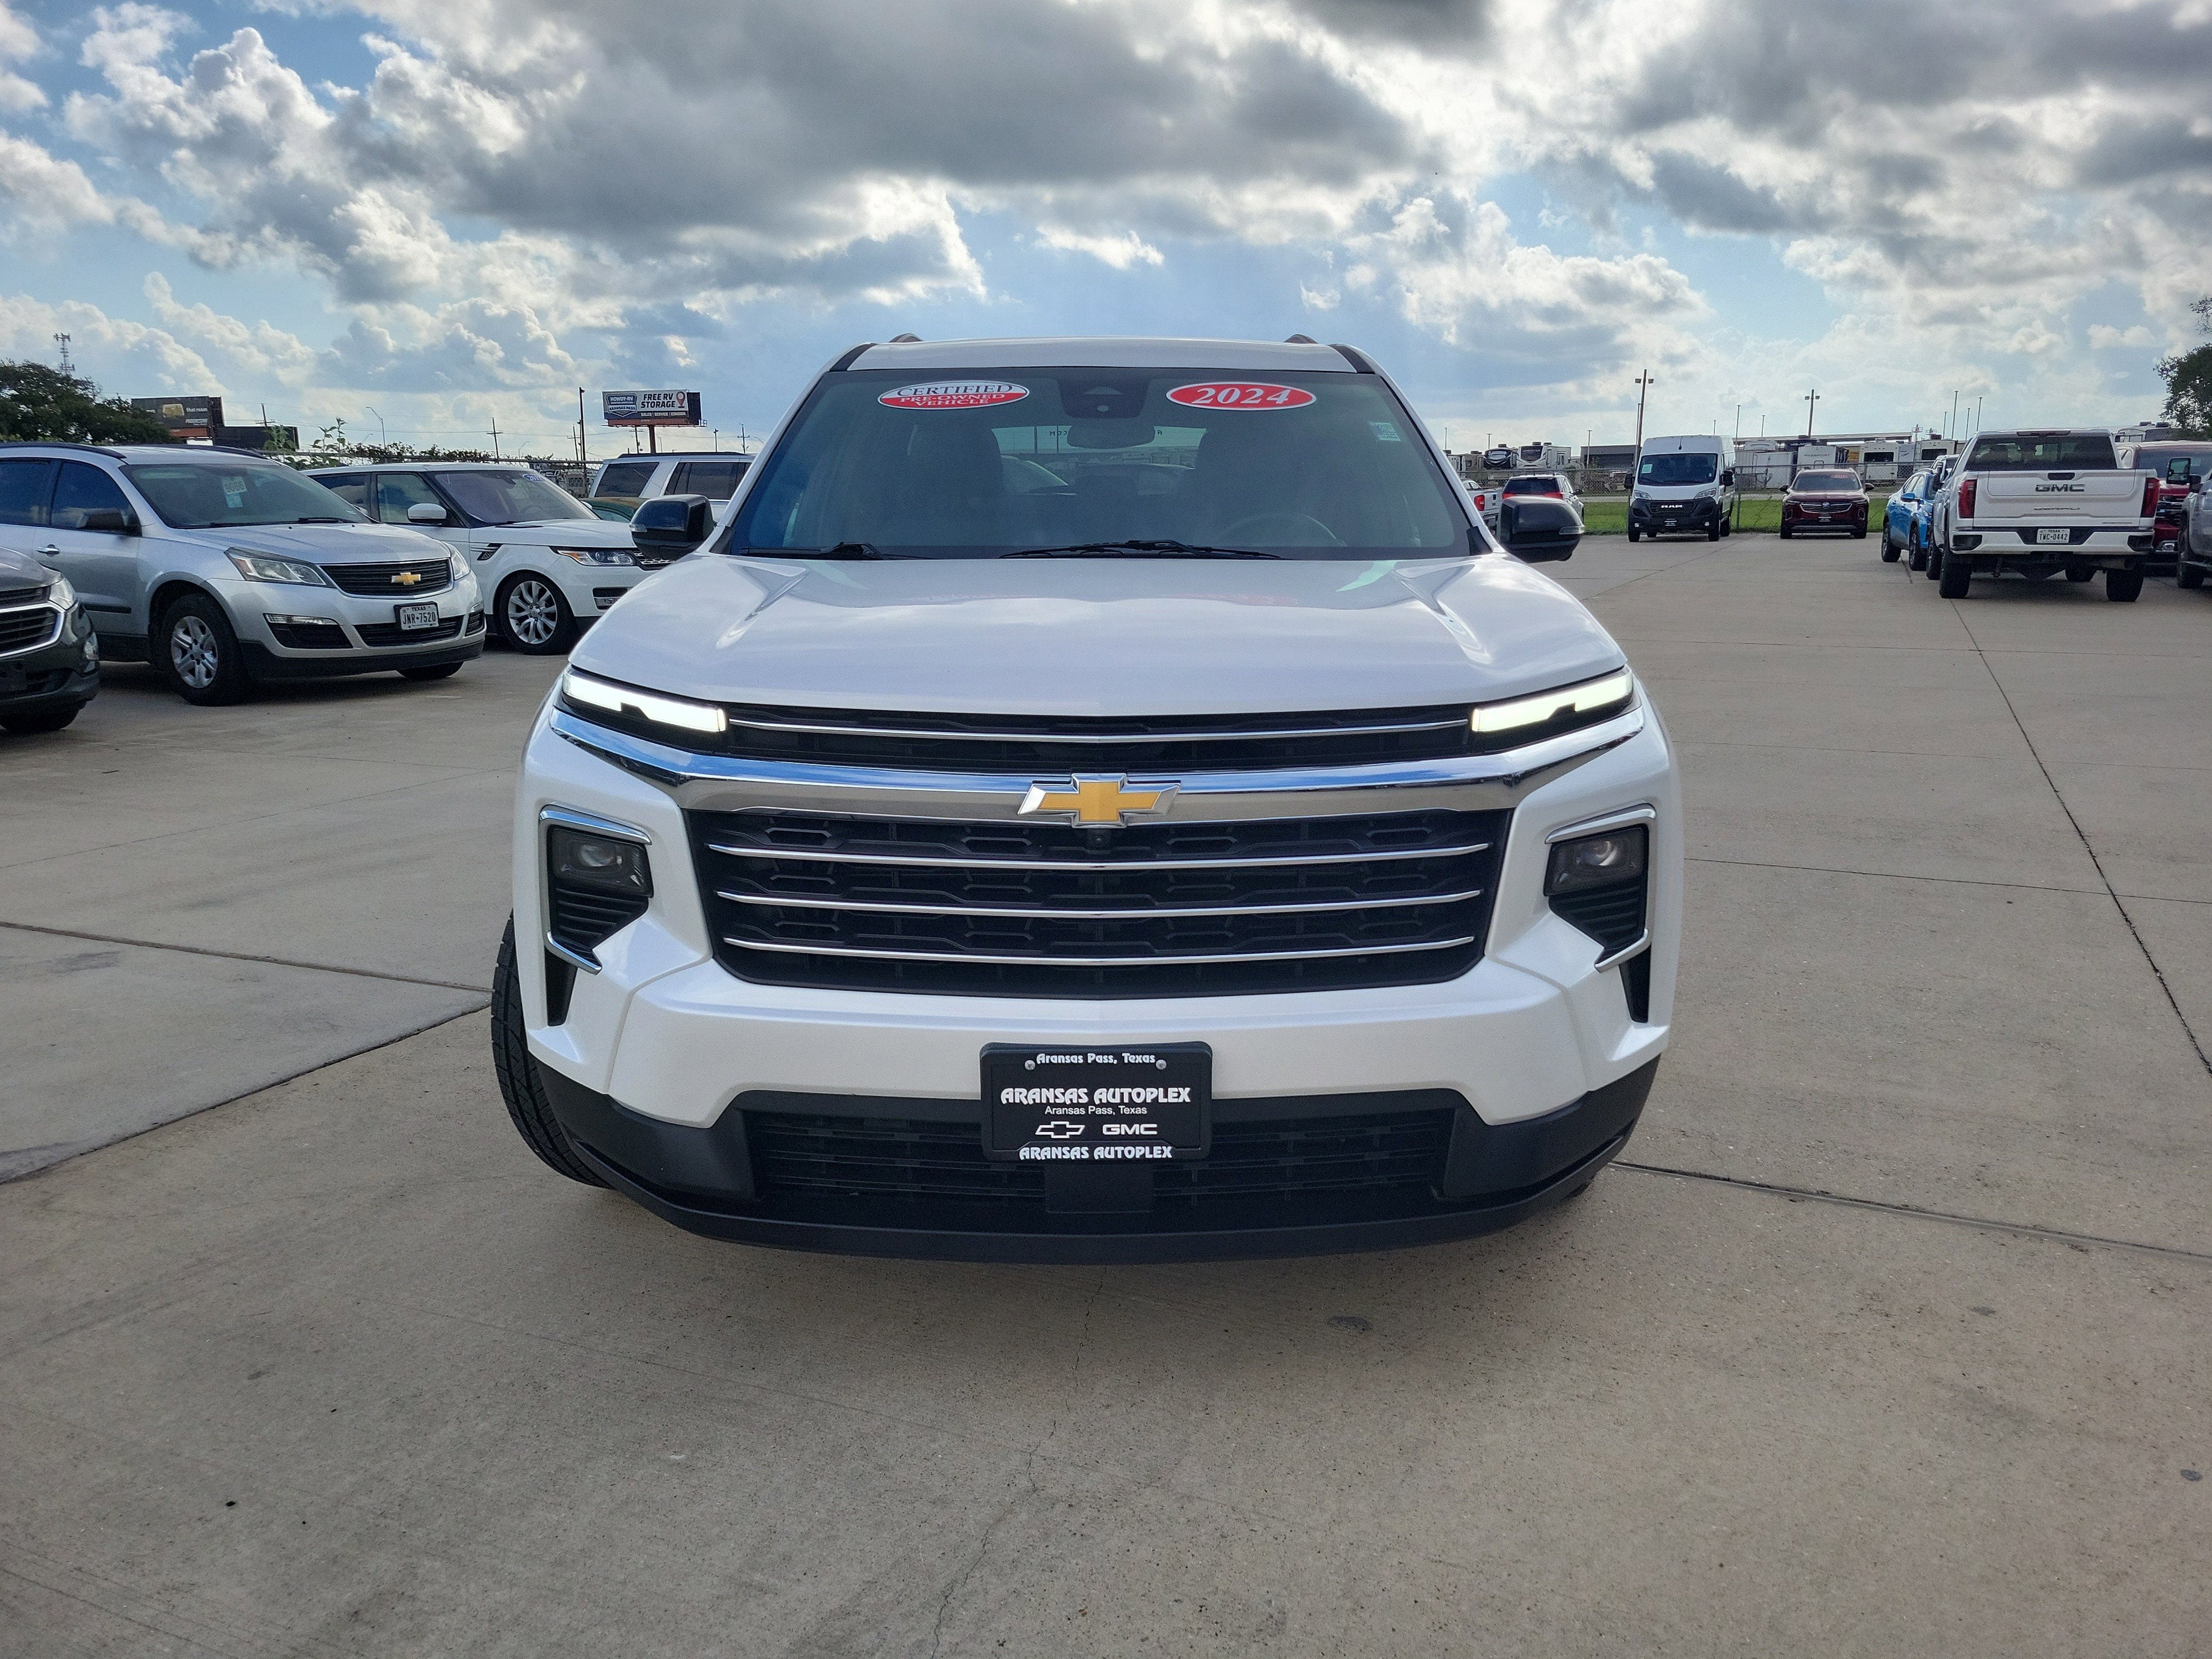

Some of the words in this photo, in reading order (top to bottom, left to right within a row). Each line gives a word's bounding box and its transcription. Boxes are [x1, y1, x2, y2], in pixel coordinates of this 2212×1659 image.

[897, 385, 1013, 396] CERTIFIED
[1191, 388, 1292, 404] 2024
[900, 394, 1005, 403] PRE-OWNED
[2035, 484, 2085, 492] GMC
[1036, 1053, 1083, 1065] Aransas
[1088, 1053, 1118, 1065] Pass,
[1122, 1053, 1155, 1064] Texas
[1000, 1088, 1088, 1105] ARANSAS
[1094, 1087, 1191, 1104] AUTOPLEX
[1045, 1106, 1086, 1115] Aransas
[1088, 1106, 1116, 1116] Pass,
[1118, 1106, 1147, 1115] Texas
[1102, 1124, 1158, 1135] GMC
[1019, 1146, 1089, 1160] ARANSAS
[1094, 1146, 1172, 1160] AUTOPLEX
